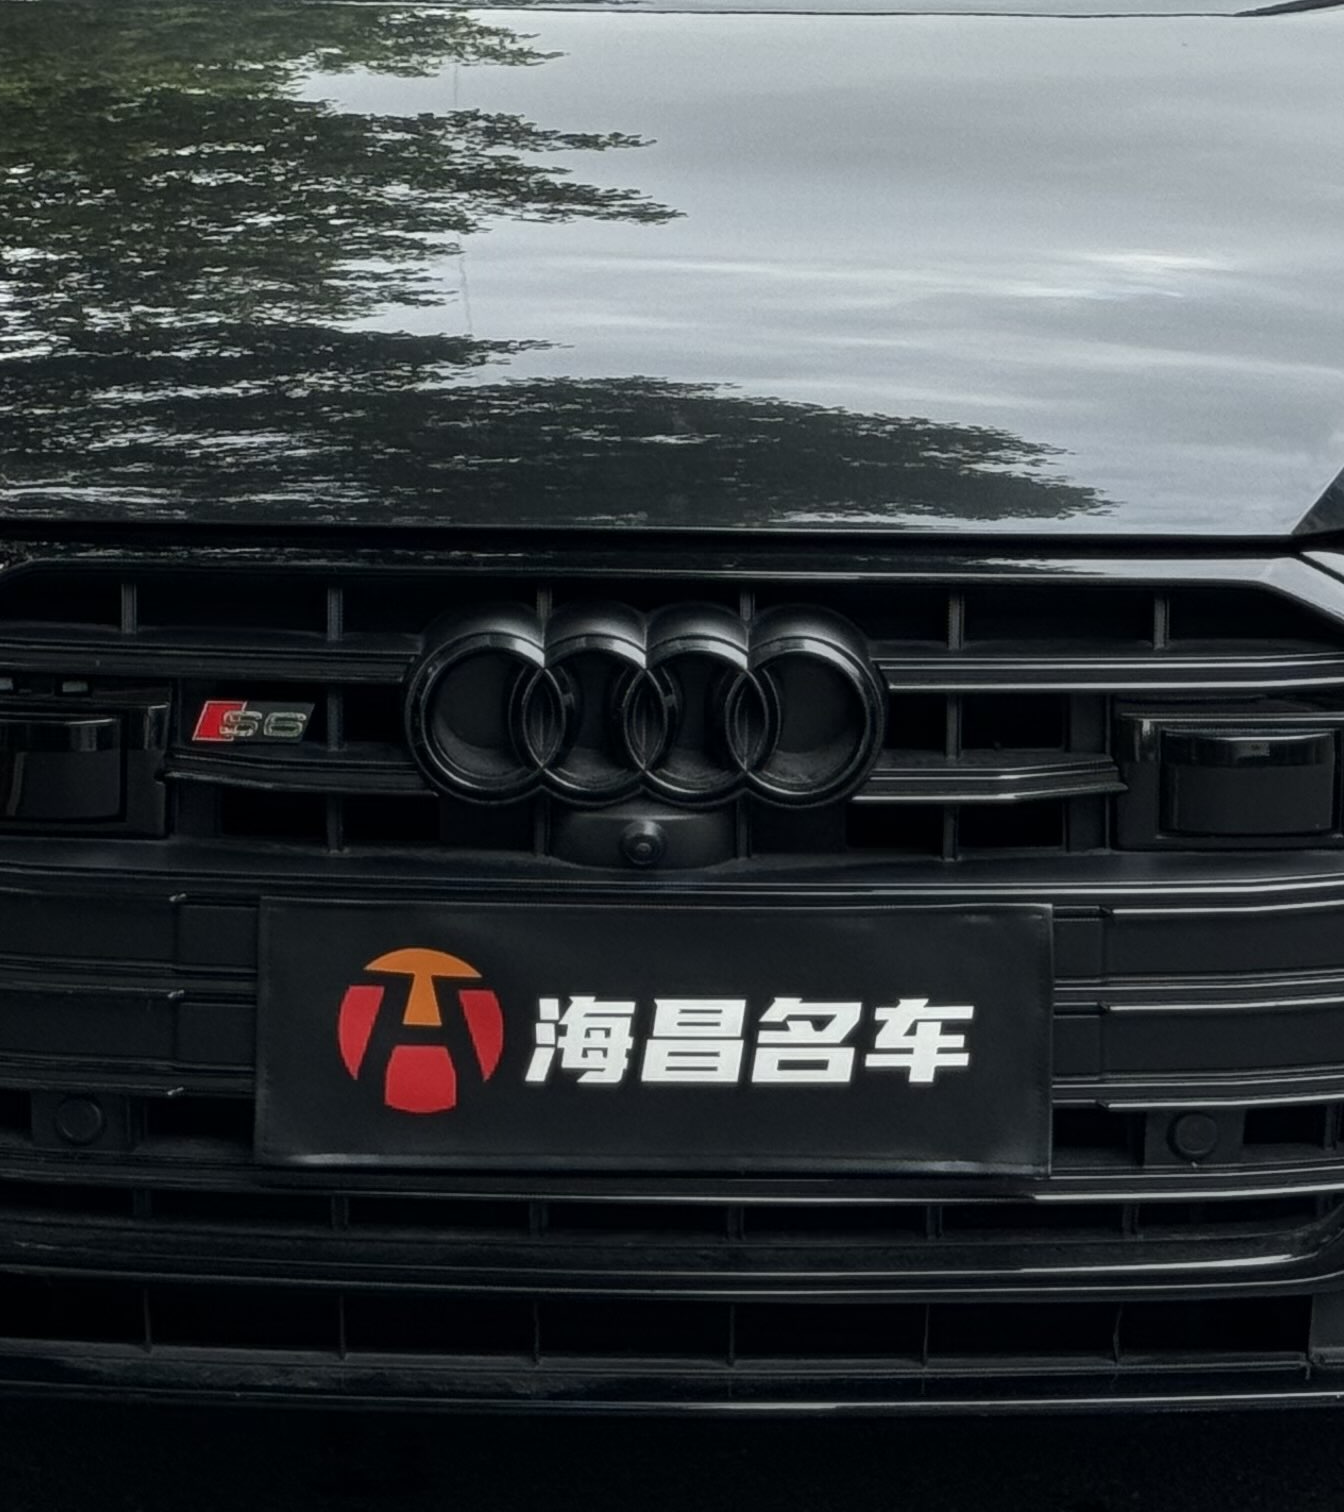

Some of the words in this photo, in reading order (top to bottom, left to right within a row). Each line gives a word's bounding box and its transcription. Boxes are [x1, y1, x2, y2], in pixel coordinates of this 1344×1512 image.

[219, 710, 307, 738] S6
[525, 995, 974, 1084] 海昌名车
